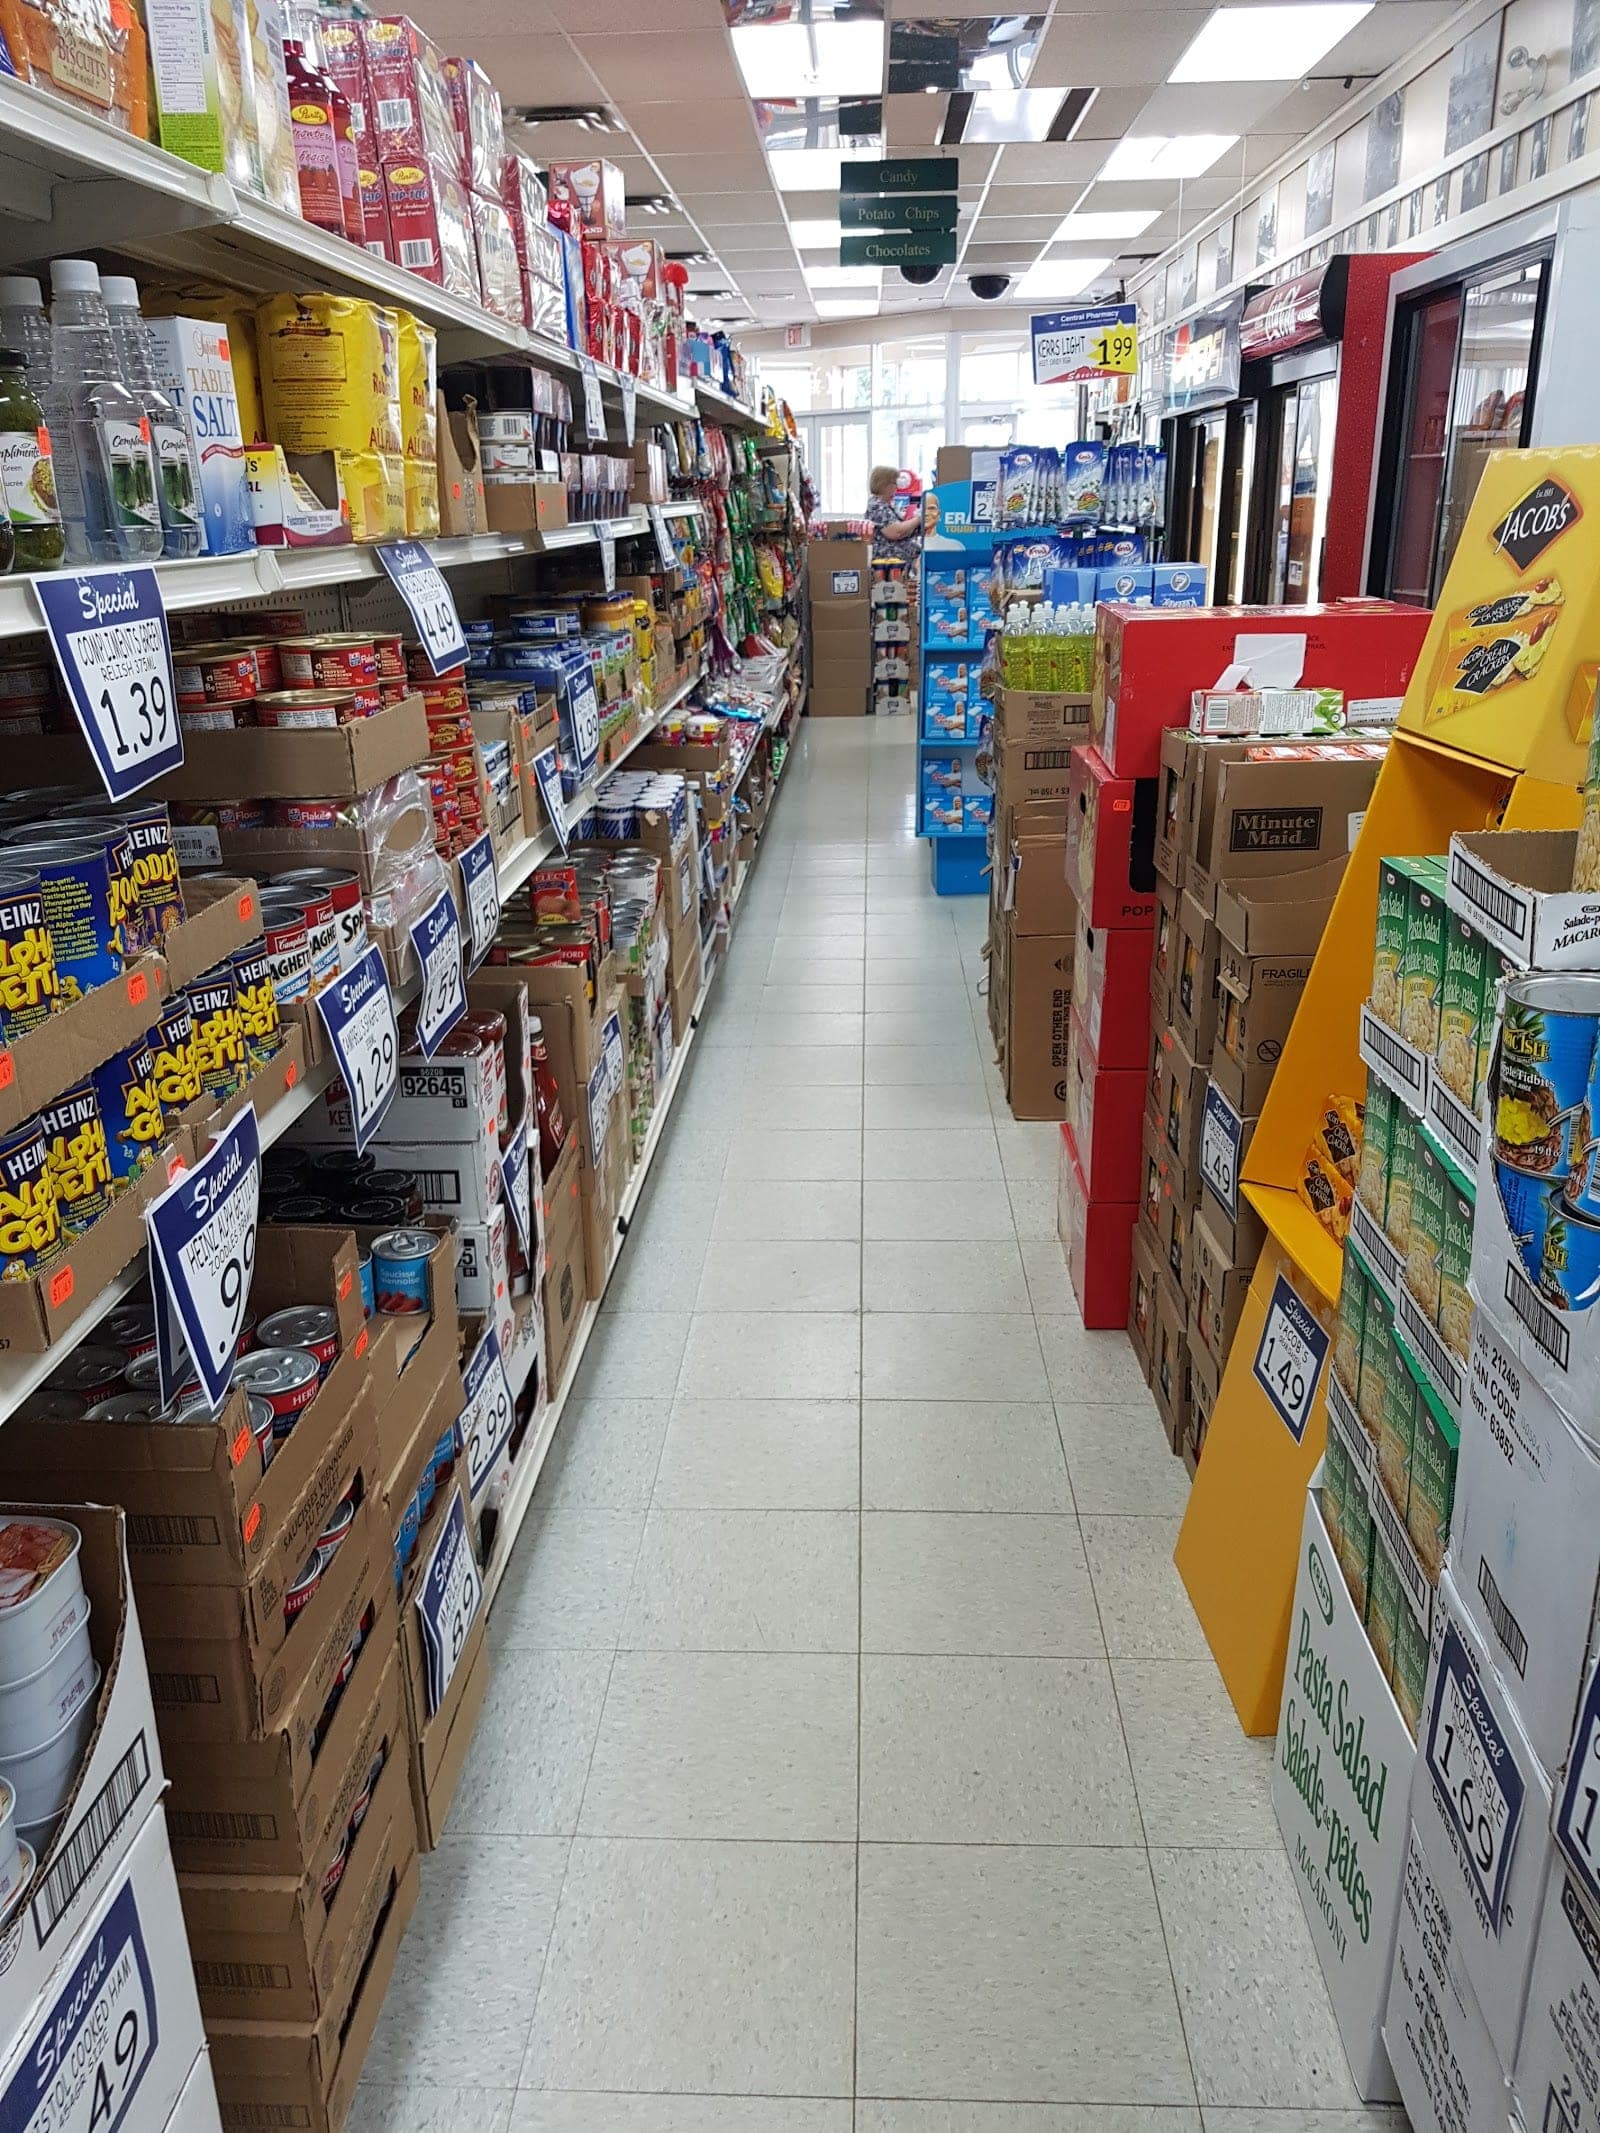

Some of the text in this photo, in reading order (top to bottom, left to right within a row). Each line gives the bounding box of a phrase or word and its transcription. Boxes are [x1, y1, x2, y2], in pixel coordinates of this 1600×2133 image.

[57, 35, 107, 80] BISCUITS
[880, 169, 918, 186] Candy
[858, 206, 940, 222] Potato Chips
[866, 243, 931, 258] Chocolates
[1060, 310, 1120, 322] Central Pharmacy
[1038, 335, 1085, 358] KERRS LIGHT
[1098, 336, 1133, 366] 1.99
[187, 367, 233, 393] TABLE
[192, 394, 240, 439] SALT
[1494, 492, 1572, 555] JACOB'S
[79, 581, 140, 625] Special
[422, 602, 456, 649] 4.49
[76, 622, 164, 666] COMPLIMENTS GREEN
[1479, 643, 1511, 667] CREAM
[100, 659, 158, 682] RELISH 375ML
[1466, 652, 1513, 688] CRACKERS
[100, 675, 168, 757] 1.39
[579, 714, 598, 753] 1.99
[1237, 813, 1316, 831] Minute
[428, 902, 450, 945] Special
[1423, 913, 1441, 945] Salad
[1552, 927, 1600, 952] MACAR
[1446, 942, 1482, 980] Pasta Salad
[342, 963, 376, 1015] Special
[425, 960, 458, 1030] 1.59
[1053, 988, 1063, 1008] END
[1052, 1009, 1063, 1041] OTHER
[356, 1031, 393, 1119] 1.29
[402, 1076, 464, 1097] 92645
[40, 1096, 97, 1135] HEINZ
[195, 1138, 244, 1220] Special
[1203, 1139, 1231, 1195] 1.49
[188, 1221, 221, 1275] HEINZ
[209, 1232, 240, 1278] ZOODLES
[1277, 1318, 1309, 1364] JACOB'S
[1285, 1297, 1316, 1342] Special
[468, 1343, 490, 1398] Special
[1263, 1336, 1305, 1411] 1.49
[1473, 1352, 1489, 1388] CAN
[1490, 1347, 1521, 1401] 212498
[462, 1413, 472, 1434] ED
[469, 1392, 507, 1477] 2.99
[1489, 1413, 1515, 1467] 63852
[303, 1515, 315, 1536] AU
[434, 1517, 458, 1594] Special
[1293, 1607, 1388, 1843] Pasta Salad
[1462, 1672, 1505, 1767] Special
[1450, 1678, 1482, 1766] TROPIC
[1478, 1762, 1507, 1828] ISLE
[1281, 1698, 1373, 1944] Salade de pâtes
[1431, 1784, 1459, 1856] Canada
[1433, 1724, 1498, 1875] 1.69
[1293, 1834, 1347, 1964] MACARONI
[1407, 1862, 1422, 1907] CAN
[1402, 1882, 1446, 1992] Item: 63852
[35, 1934, 108, 2091] Special
[70, 1953, 132, 2073] COOKED HAM
[1414, 1992, 1424, 2014] of
[1405, 2021, 1432, 2100] Canada
[1417, 1967, 1472, 2116] PACKED FOR:
[1558, 1998, 1599, 2095] PÊCHES
[1560, 2073, 1581, 2130] 24
